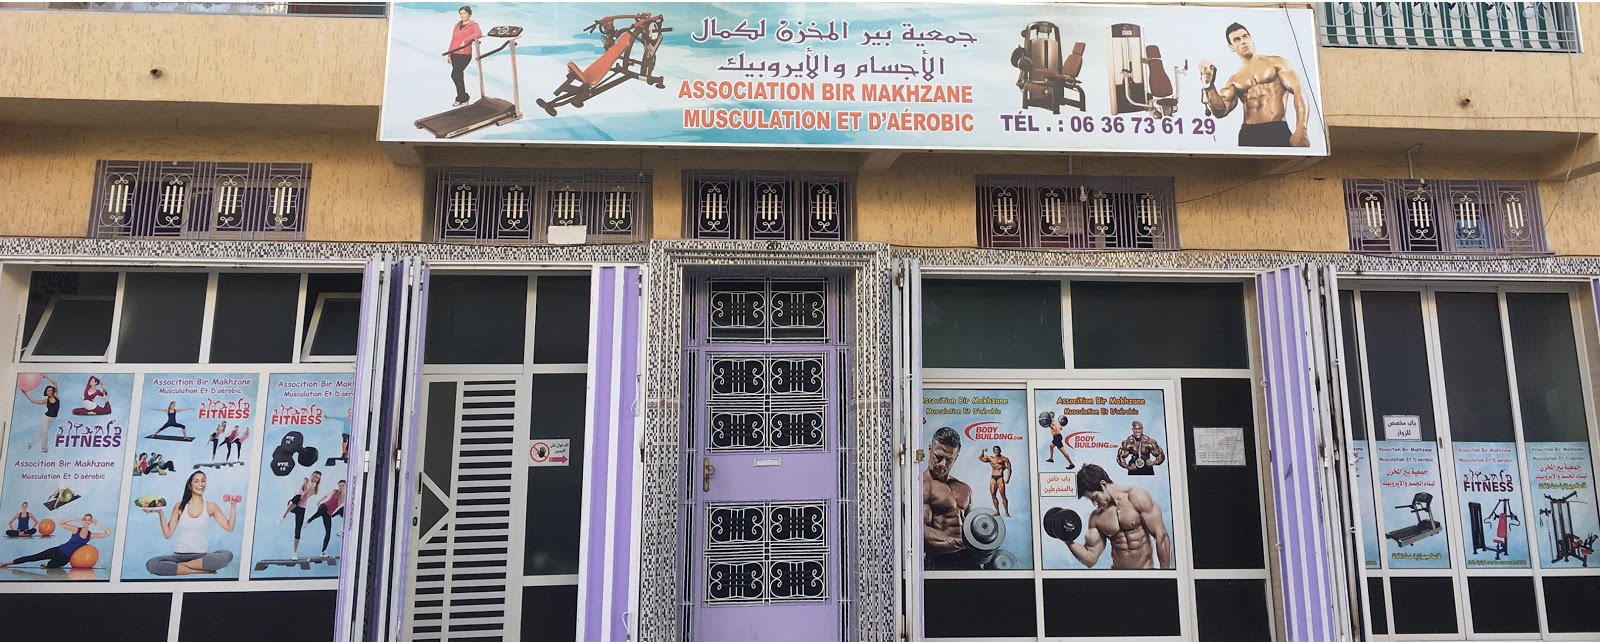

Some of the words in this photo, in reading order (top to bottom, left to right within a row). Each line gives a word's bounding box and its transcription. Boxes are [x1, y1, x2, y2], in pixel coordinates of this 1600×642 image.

[692, 17, 766, 43] لكمال
[776, 20, 848, 45] المخزن
[862, 27, 892, 46] بير
[902, 23, 977, 47] جمعية
[717, 48, 846, 79] والأيروبيك
[854, 50, 944, 81] الأجسام
[678, 80, 814, 101] ASSOCIATION
[821, 82, 855, 102] BIR
[862, 83, 973, 104] MAKHZANE
[683, 109, 830, 130] MUSCULATION
[837, 111, 862, 131] ET
[1070, 115, 1094, 133] 06
[1101, 116, 1125, 134] 36
[1131, 117, 1155, 134] 73
[1161, 117, 1184, 135] 61
[1192, 118, 1216, 135] 29
[153, 378, 194, 386] Assocition
[197, 378, 208, 386] Bir
[212, 378, 252, 386] Makhzane
[321, 380, 332, 388] Bir
[1096, 396, 1107, 405] Bir
[198, 409, 250, 419] FITNESS
[271, 415, 322, 425] FITNESS
[55, 435, 122, 448] FITNESS
[14, 460, 57, 468] Assocition
[74, 460, 115, 468] Makhzane
[1463, 482, 1514, 492] FITNESS
